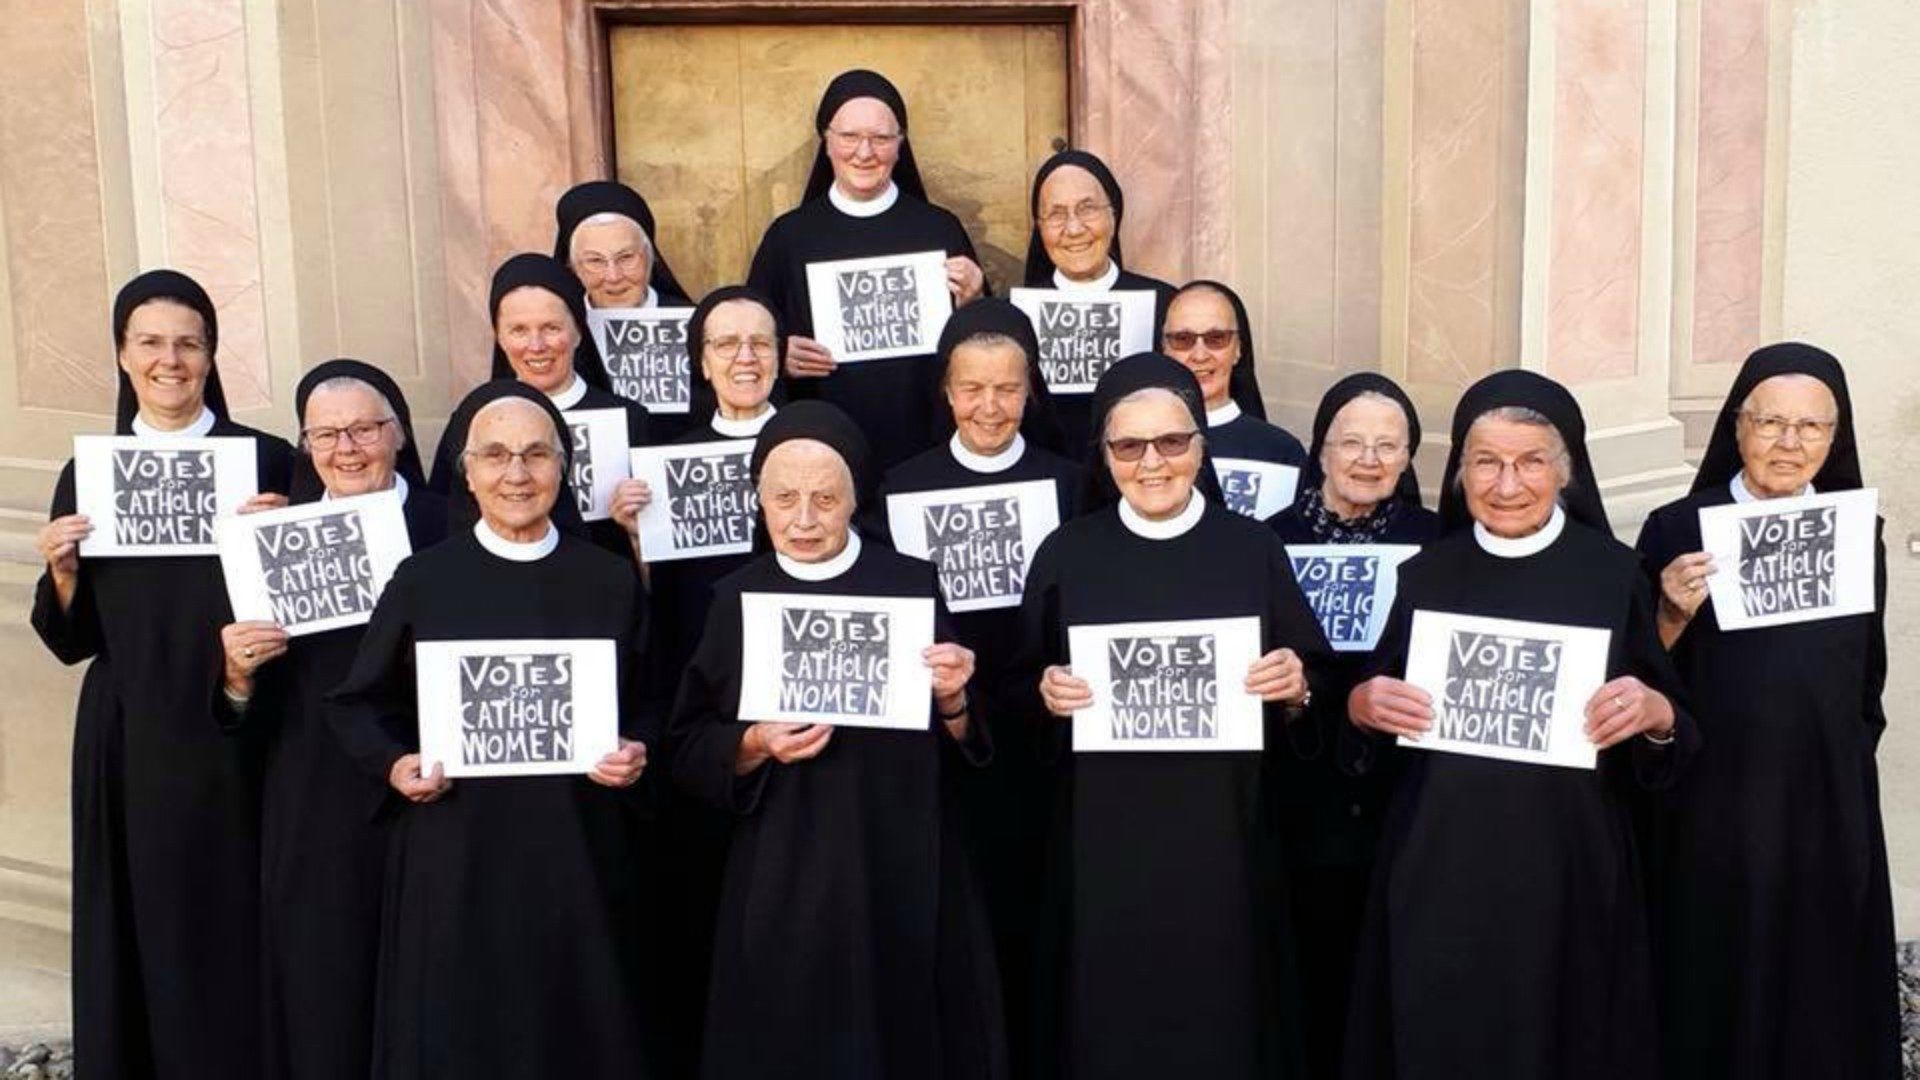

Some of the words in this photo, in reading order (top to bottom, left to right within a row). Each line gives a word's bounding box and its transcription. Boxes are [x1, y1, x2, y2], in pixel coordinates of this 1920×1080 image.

[839, 302, 919, 327] CATHOLIC
[842, 323, 920, 351] WOMEN
[1039, 360, 1111, 384] WOME
[113, 490, 216, 515] CATHOLIC
[114, 515, 215, 545] WOMEN
[264, 555, 373, 595] CATHOLIC
[1738, 550, 1834, 585] CATHOLIC
[269, 583, 377, 627] WOMEN
[1306, 592, 1375, 615] THOLIC
[1740, 576, 1836, 617] WOMEN
[781, 651, 889, 683] CATHOLIC
[780, 681, 887, 715] WOMEN
[1110, 678, 1216, 706] CATHOLIC
[1443, 677, 1555, 714] CATHOLIC
[461, 700, 572, 729] CATHOLIC
[1110, 705, 1217, 740] WOMEN
[1438, 708, 1551, 751] WOMEN
[461, 728, 573, 764] WOMEN
